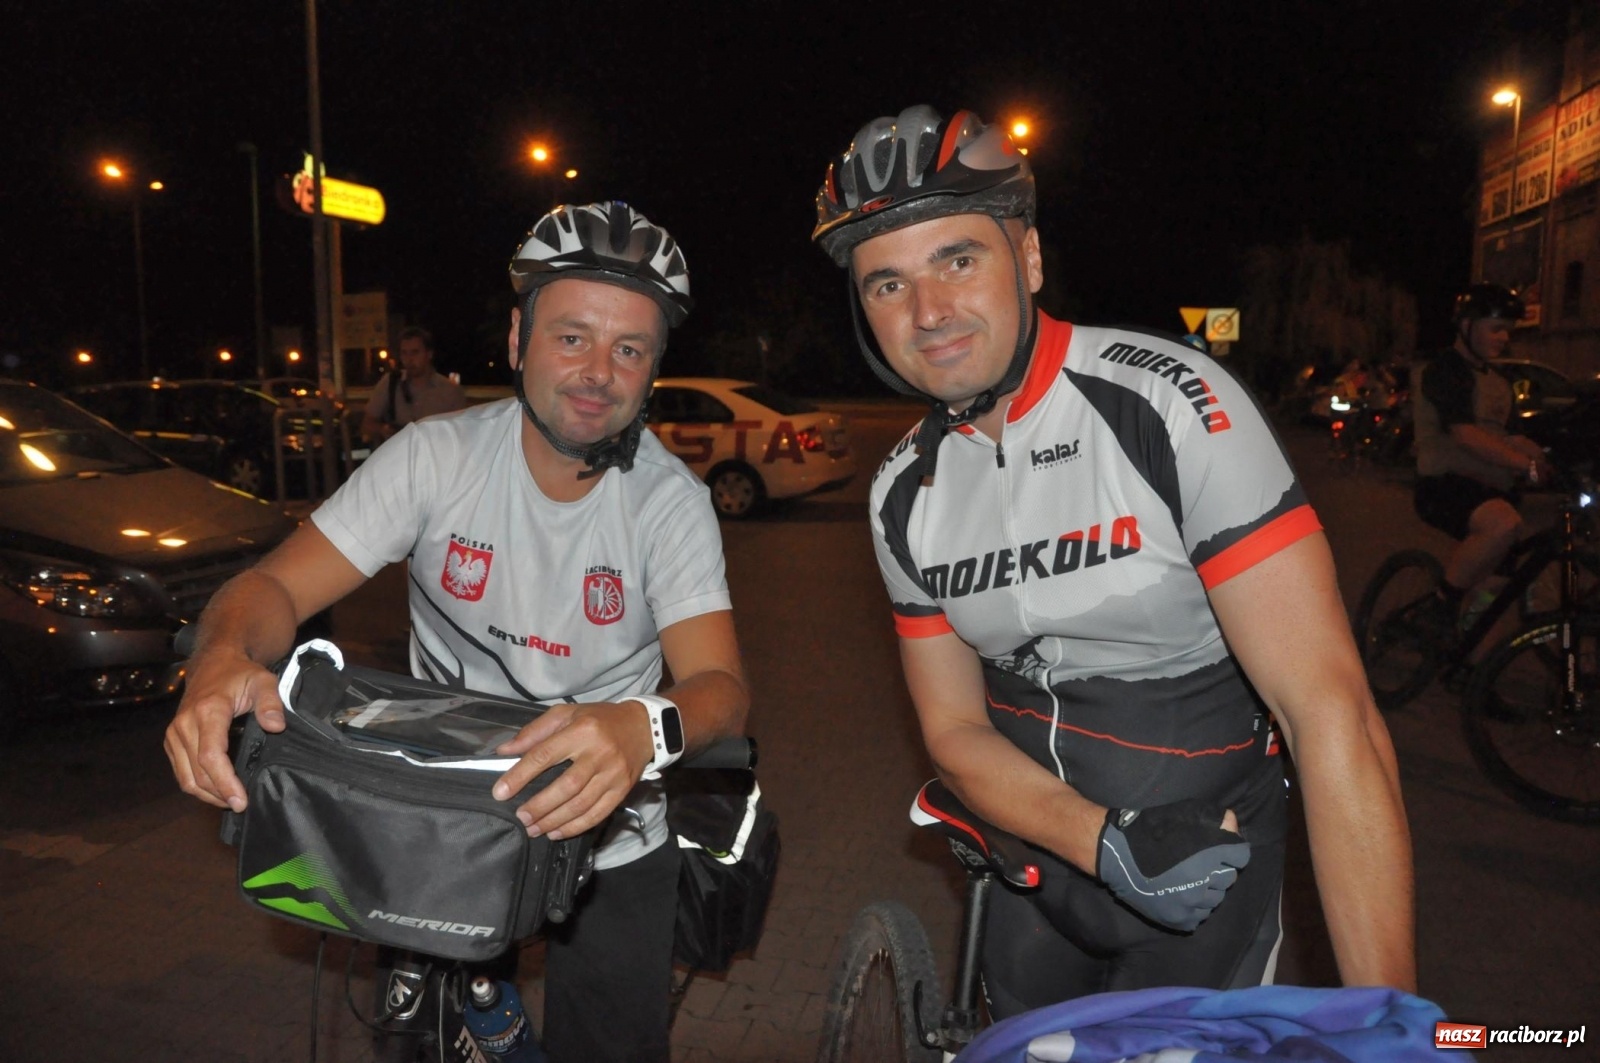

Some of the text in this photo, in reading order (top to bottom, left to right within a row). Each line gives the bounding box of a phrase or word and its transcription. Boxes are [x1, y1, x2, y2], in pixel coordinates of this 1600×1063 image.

[1099, 342, 1231, 433] MOJEKOLO
[652, 421, 805, 464] STA
[1030, 438, 1080, 467] kalas
[450, 533, 494, 552] POLSKA
[921, 516, 1141, 599] MOJEKOLO
[1156, 876, 1210, 896] FORMULA
[368, 909, 496, 937] MERIDA
